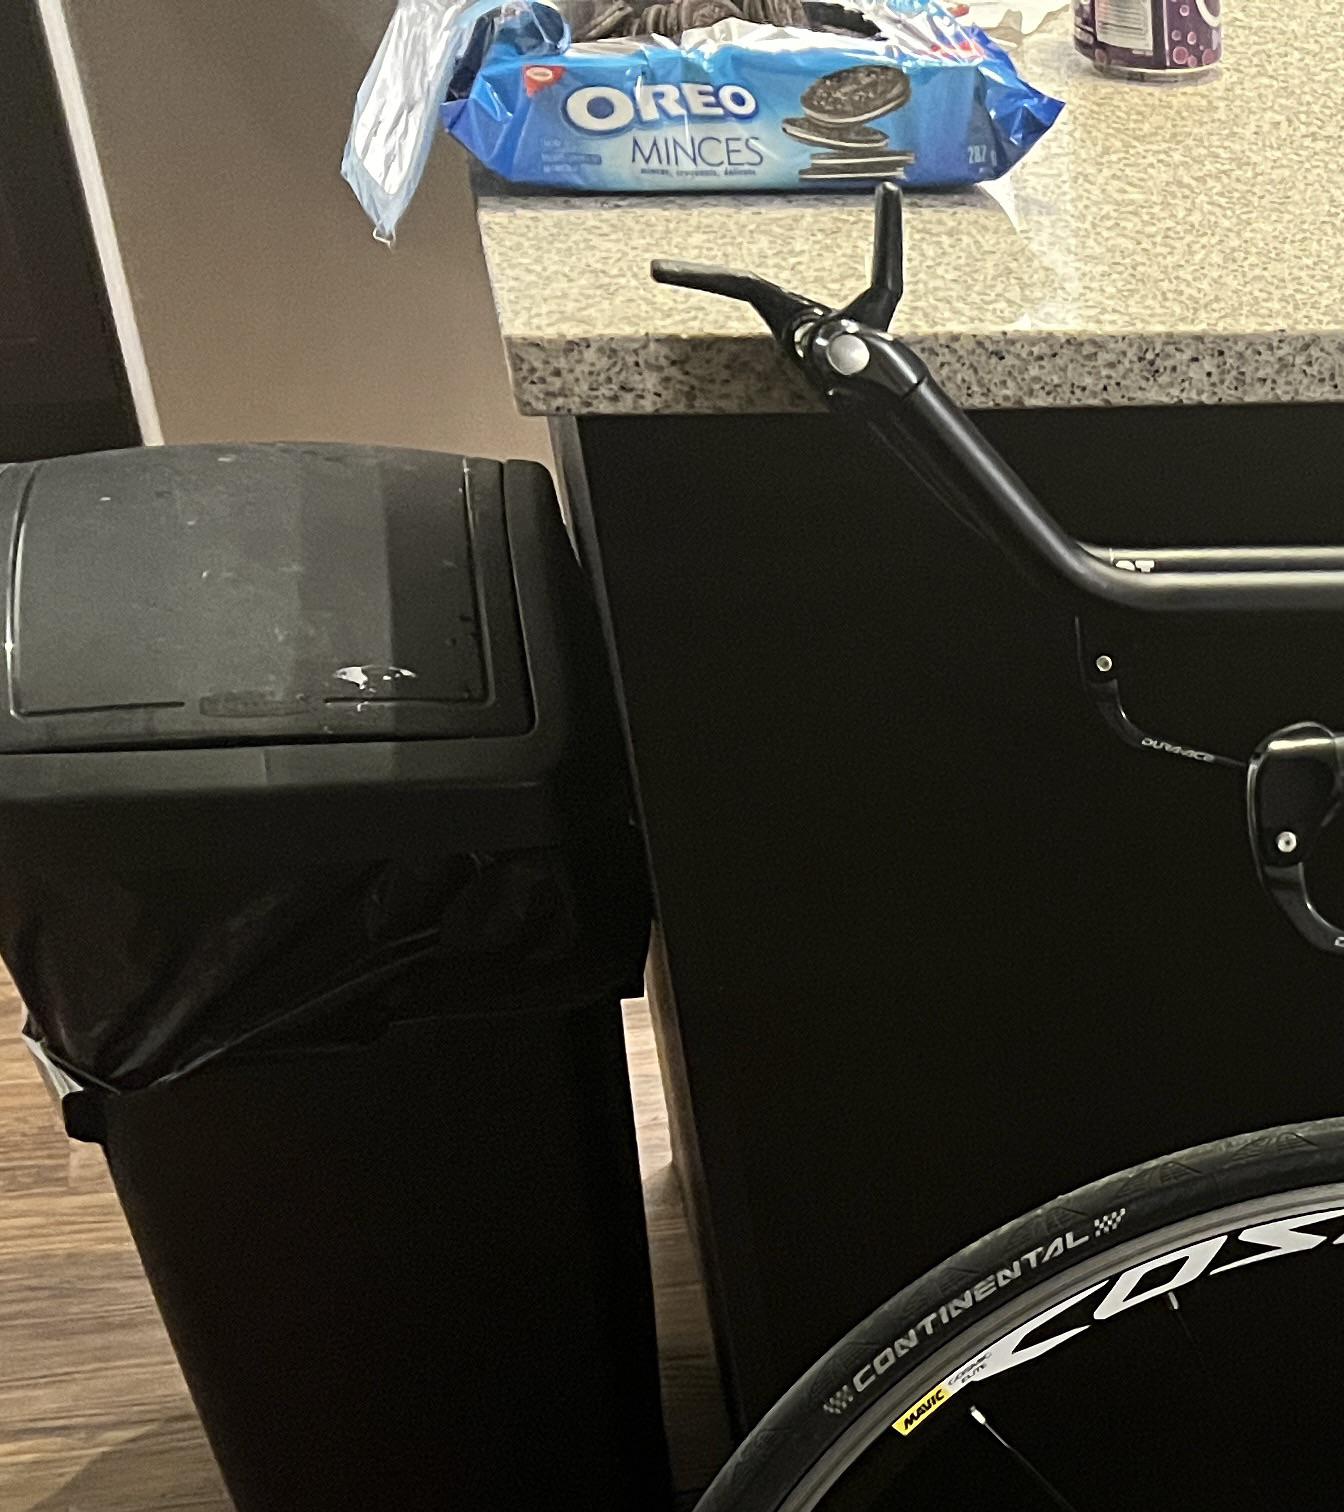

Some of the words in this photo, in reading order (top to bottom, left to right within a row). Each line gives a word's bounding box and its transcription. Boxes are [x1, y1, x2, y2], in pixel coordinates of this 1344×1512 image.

[566, 82, 757, 132] OREO
[631, 135, 764, 167] MINCES
[852, 1229, 1091, 1396] CONTINENTAL
[903, 1388, 946, 1431] MAVIC
